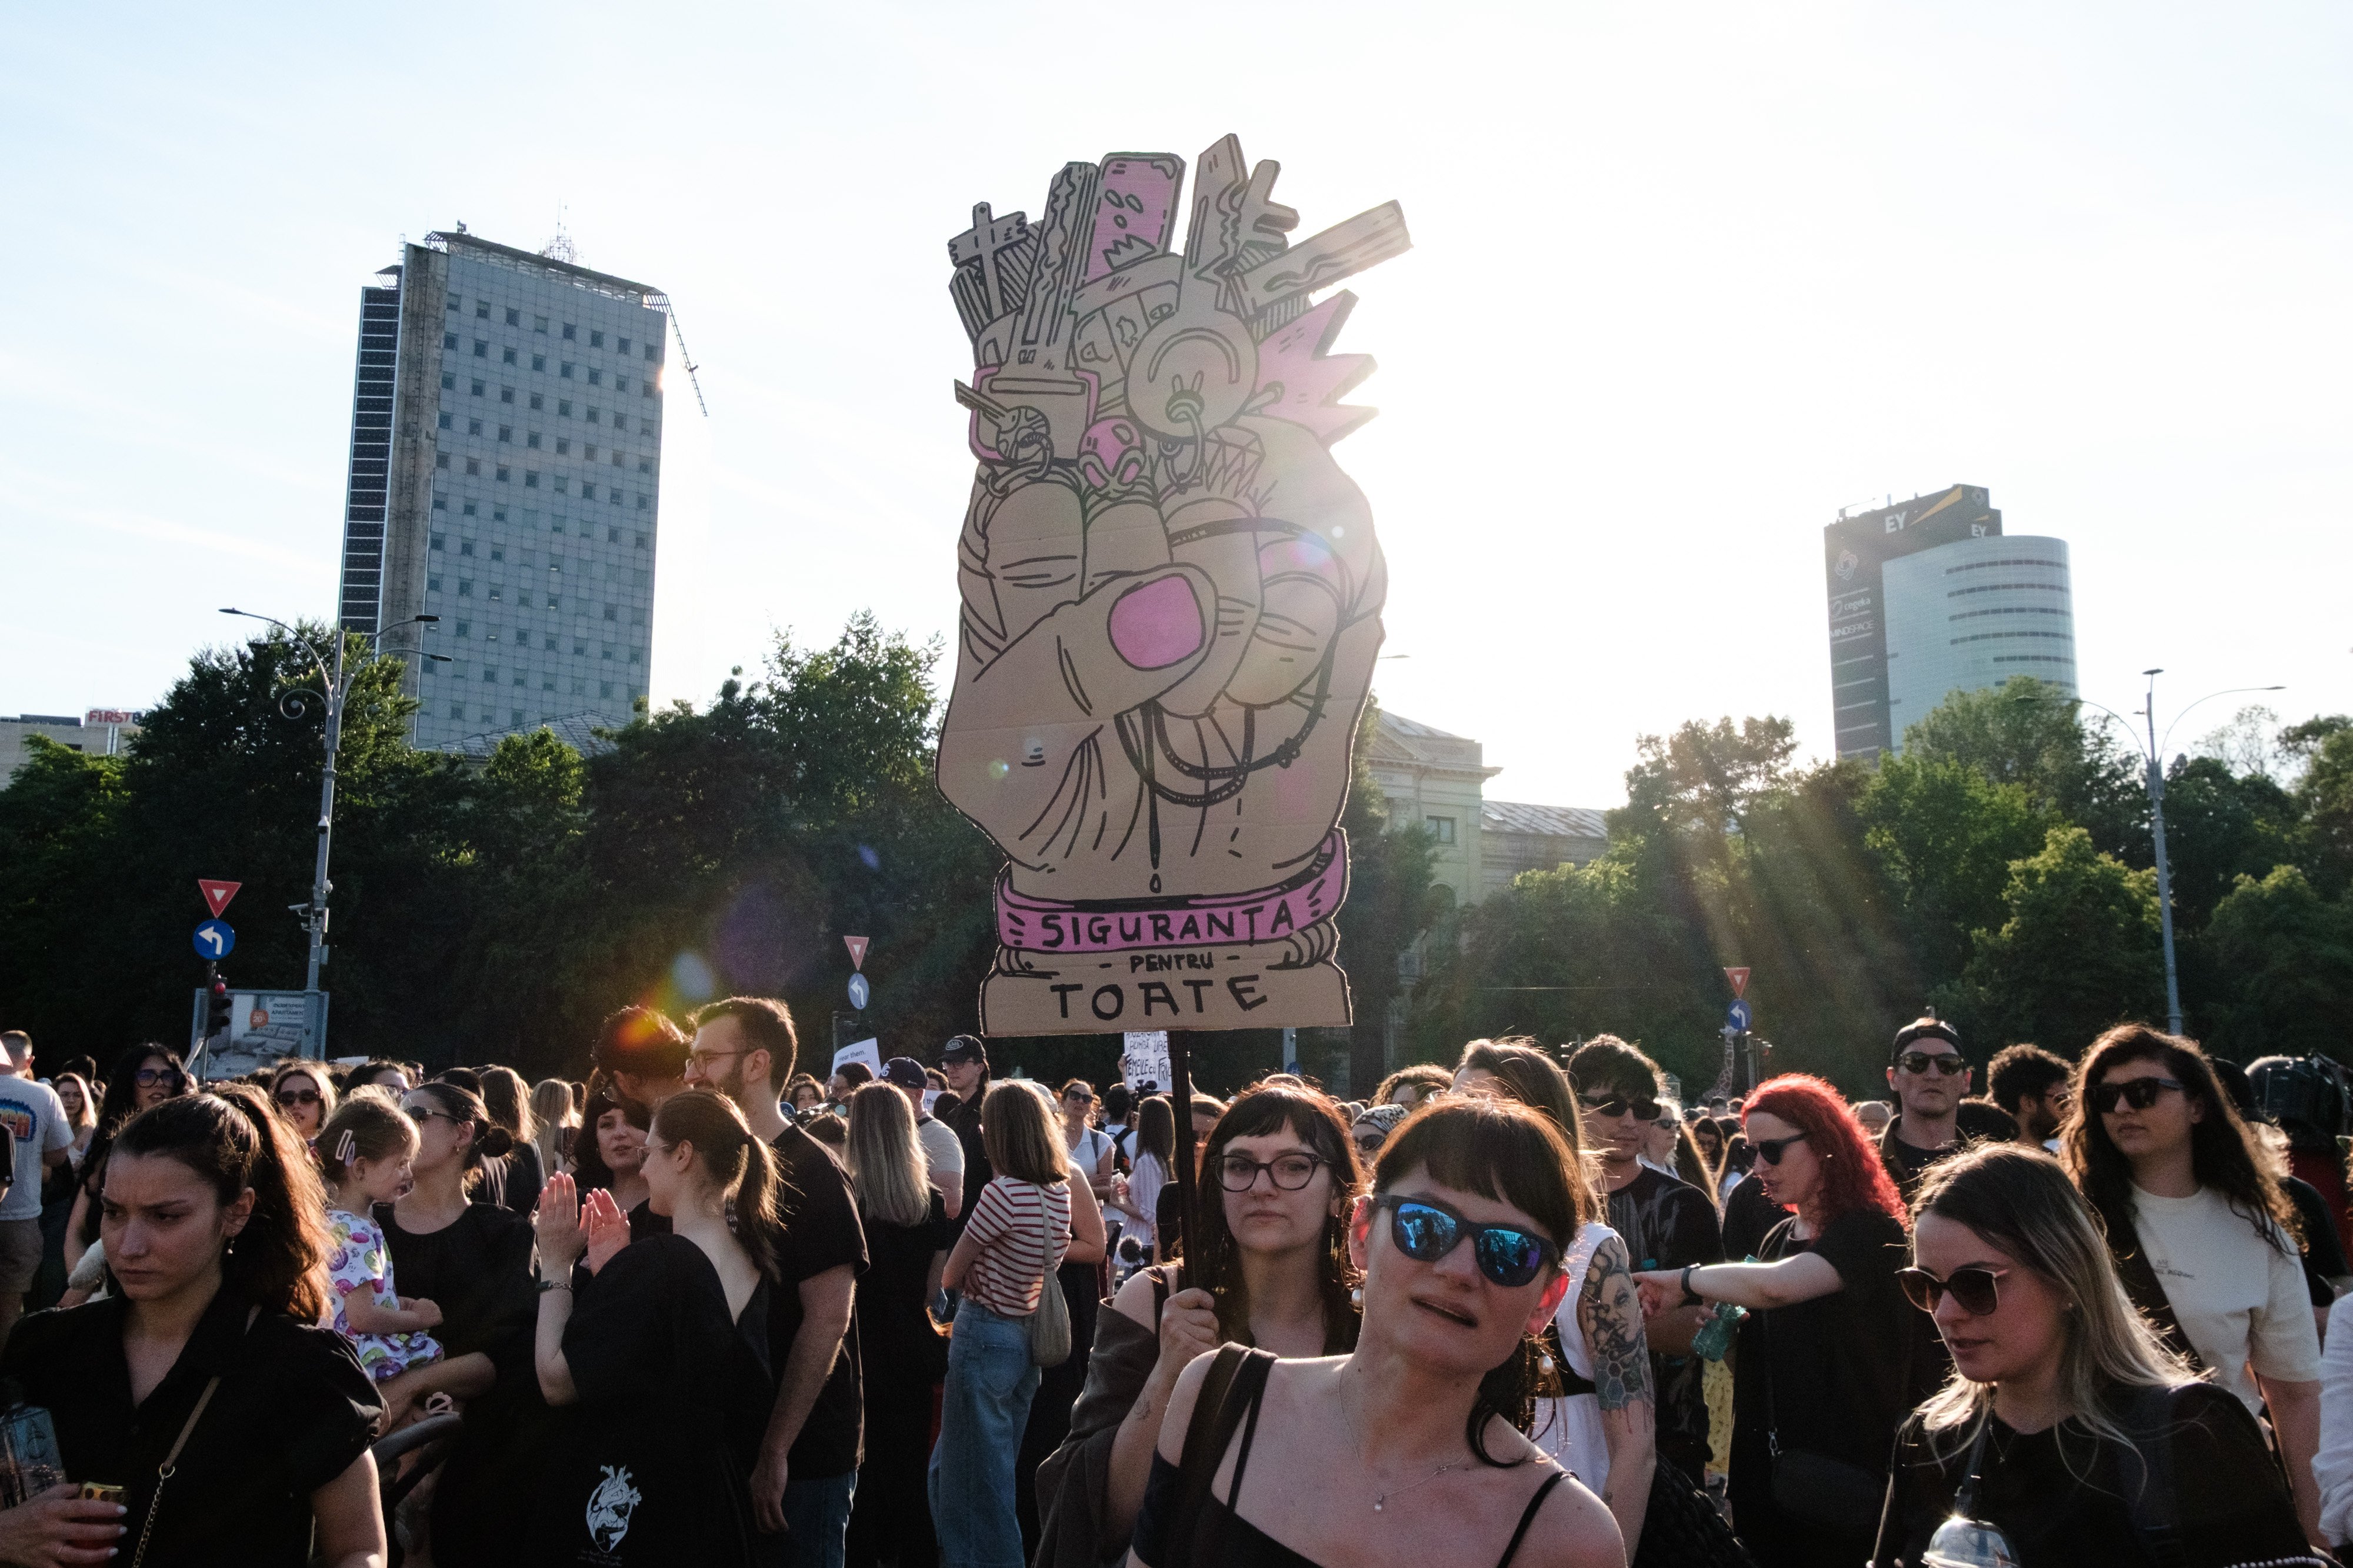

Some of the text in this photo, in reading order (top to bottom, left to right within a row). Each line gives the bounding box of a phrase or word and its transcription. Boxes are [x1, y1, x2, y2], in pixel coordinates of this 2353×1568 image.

[1885, 511, 1907, 533] EY
[1971, 523, 1987, 539] EY
[1845, 598, 1871, 610] cegeka
[1829, 620, 1874, 638] MINDSPACE
[88, 710, 131, 723] FIRST
[1130, 952, 1214, 973] PENTRU
[1050, 974, 1268, 1020] TOATE
[1158, 1057, 1172, 1081] FRIC
